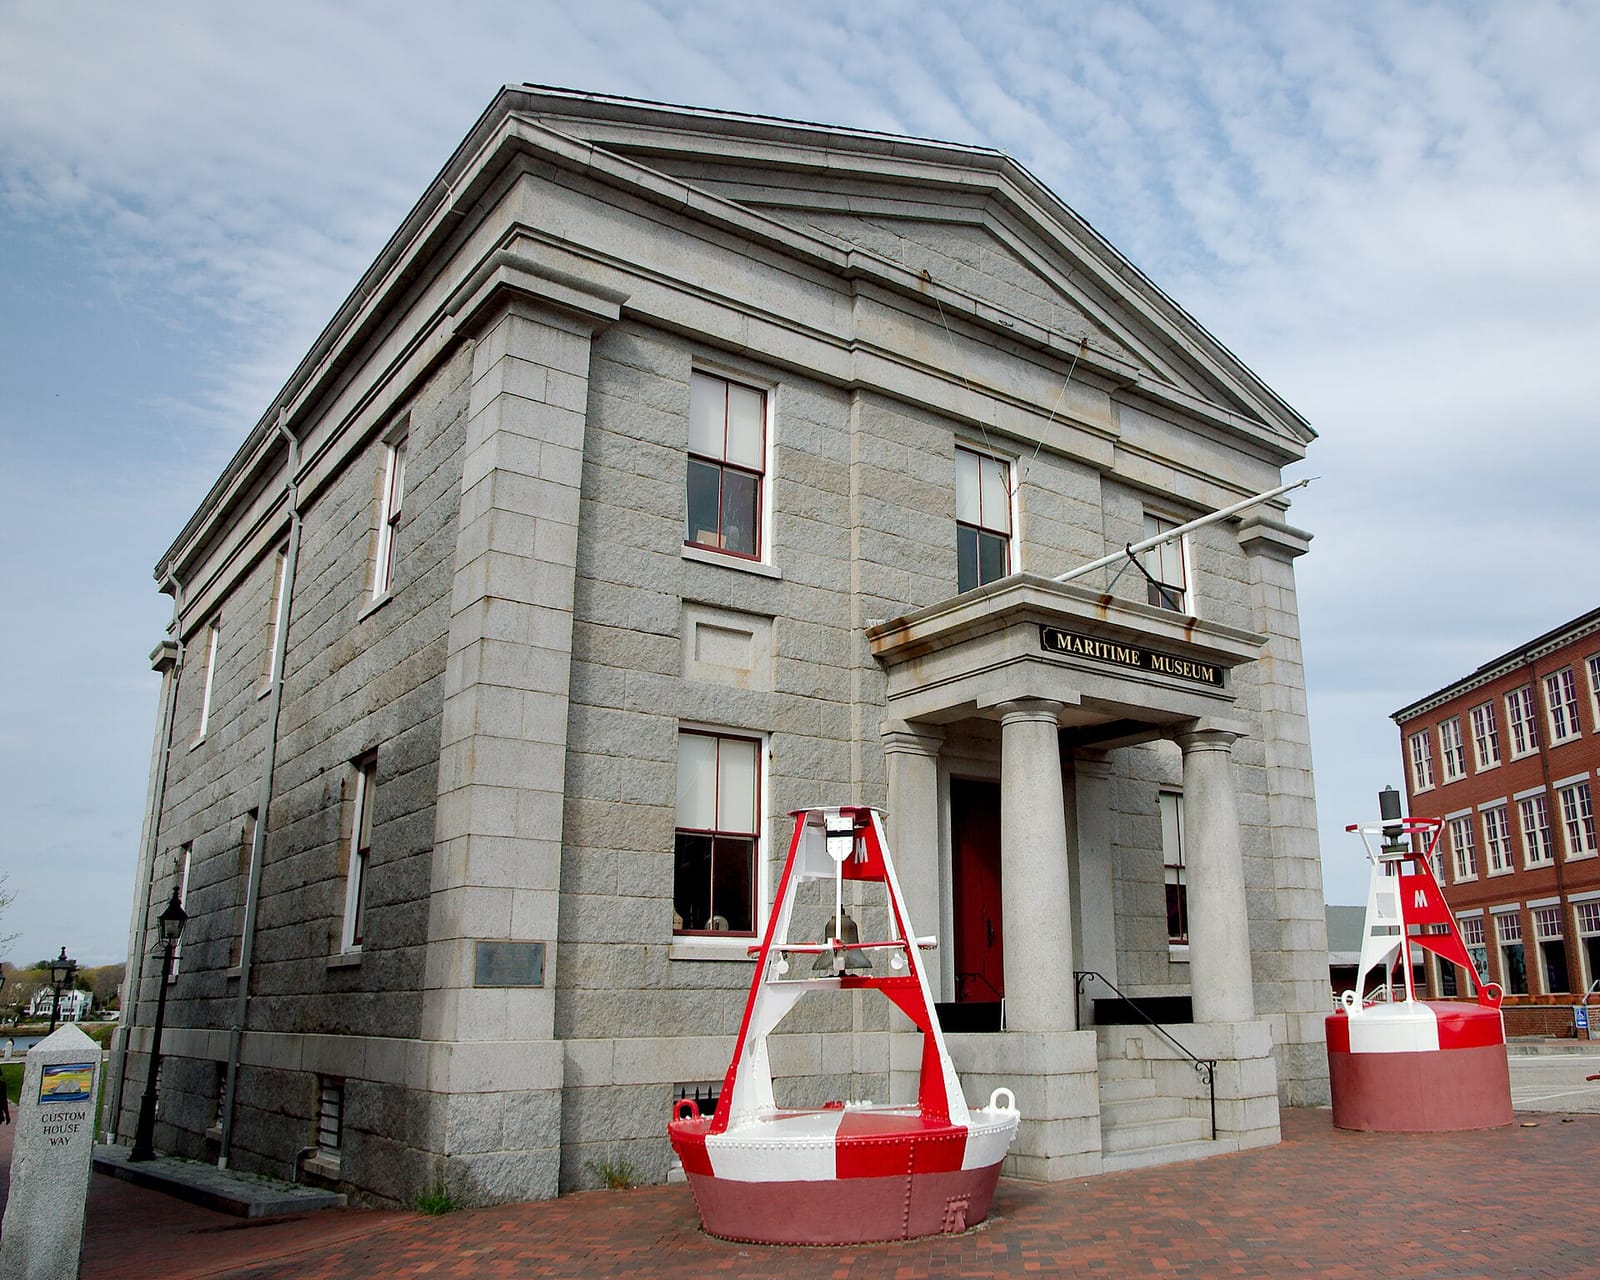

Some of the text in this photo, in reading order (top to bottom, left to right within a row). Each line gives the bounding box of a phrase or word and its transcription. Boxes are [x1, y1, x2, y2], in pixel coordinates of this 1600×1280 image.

[1057, 633, 1214, 682] MARITIME MUSEUM
[854, 836, 868, 864] M
[1414, 889, 1428, 908] M
[41, 1112, 86, 1123] CUSTOM
[43, 1124, 80, 1134] HOUSE
[49, 1137, 71, 1146] WAY
